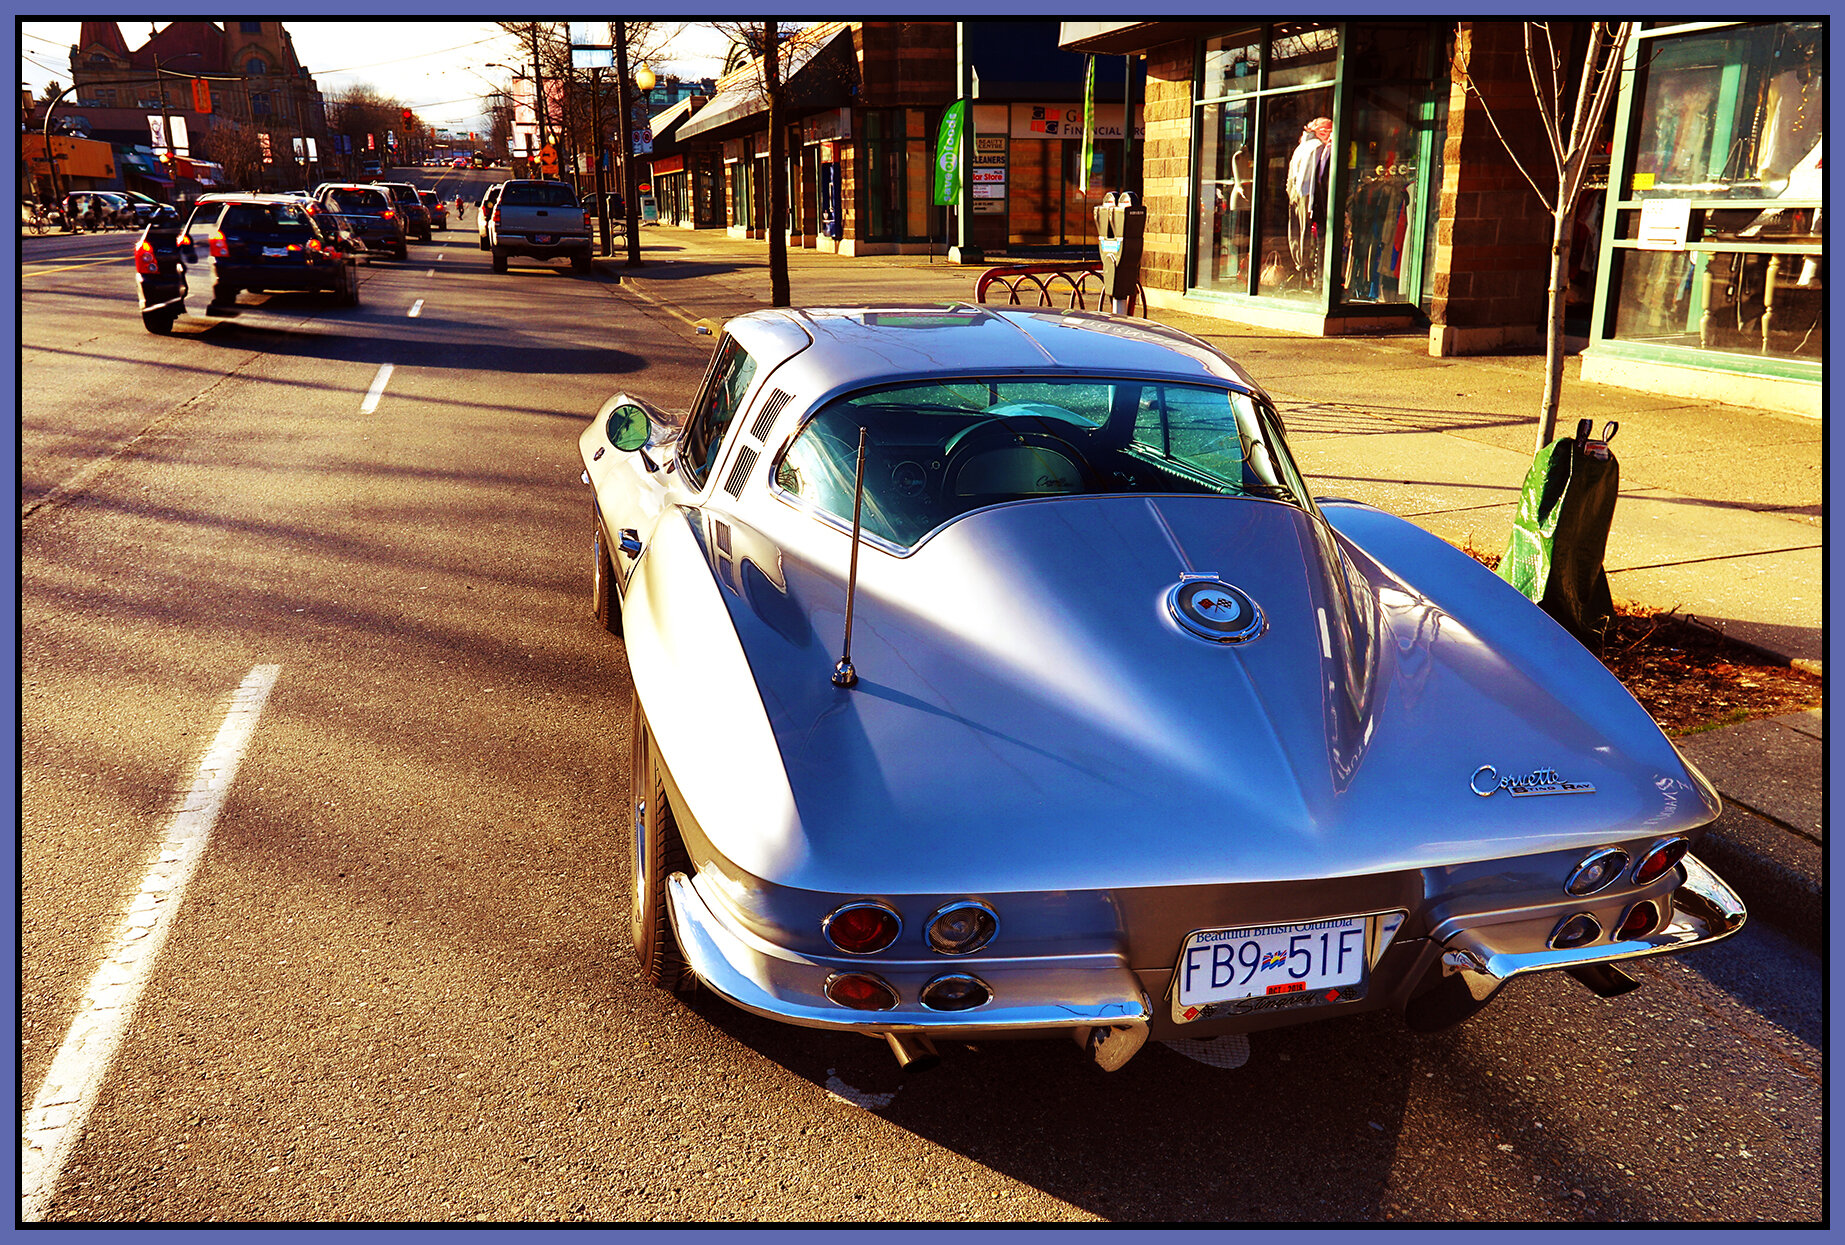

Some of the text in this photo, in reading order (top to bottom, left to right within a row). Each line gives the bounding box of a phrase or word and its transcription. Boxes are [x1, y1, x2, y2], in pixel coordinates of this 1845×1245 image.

[1064, 123, 1122, 135] FINNCIAL
[983, 173, 1003, 181] Store
[1470, 765, 1568, 797] Corvette
[1196, 918, 1353, 943] Beautiful British Columbia
[1185, 929, 1362, 992] FB9 51F
[1227, 993, 1317, 1016] Stingray
